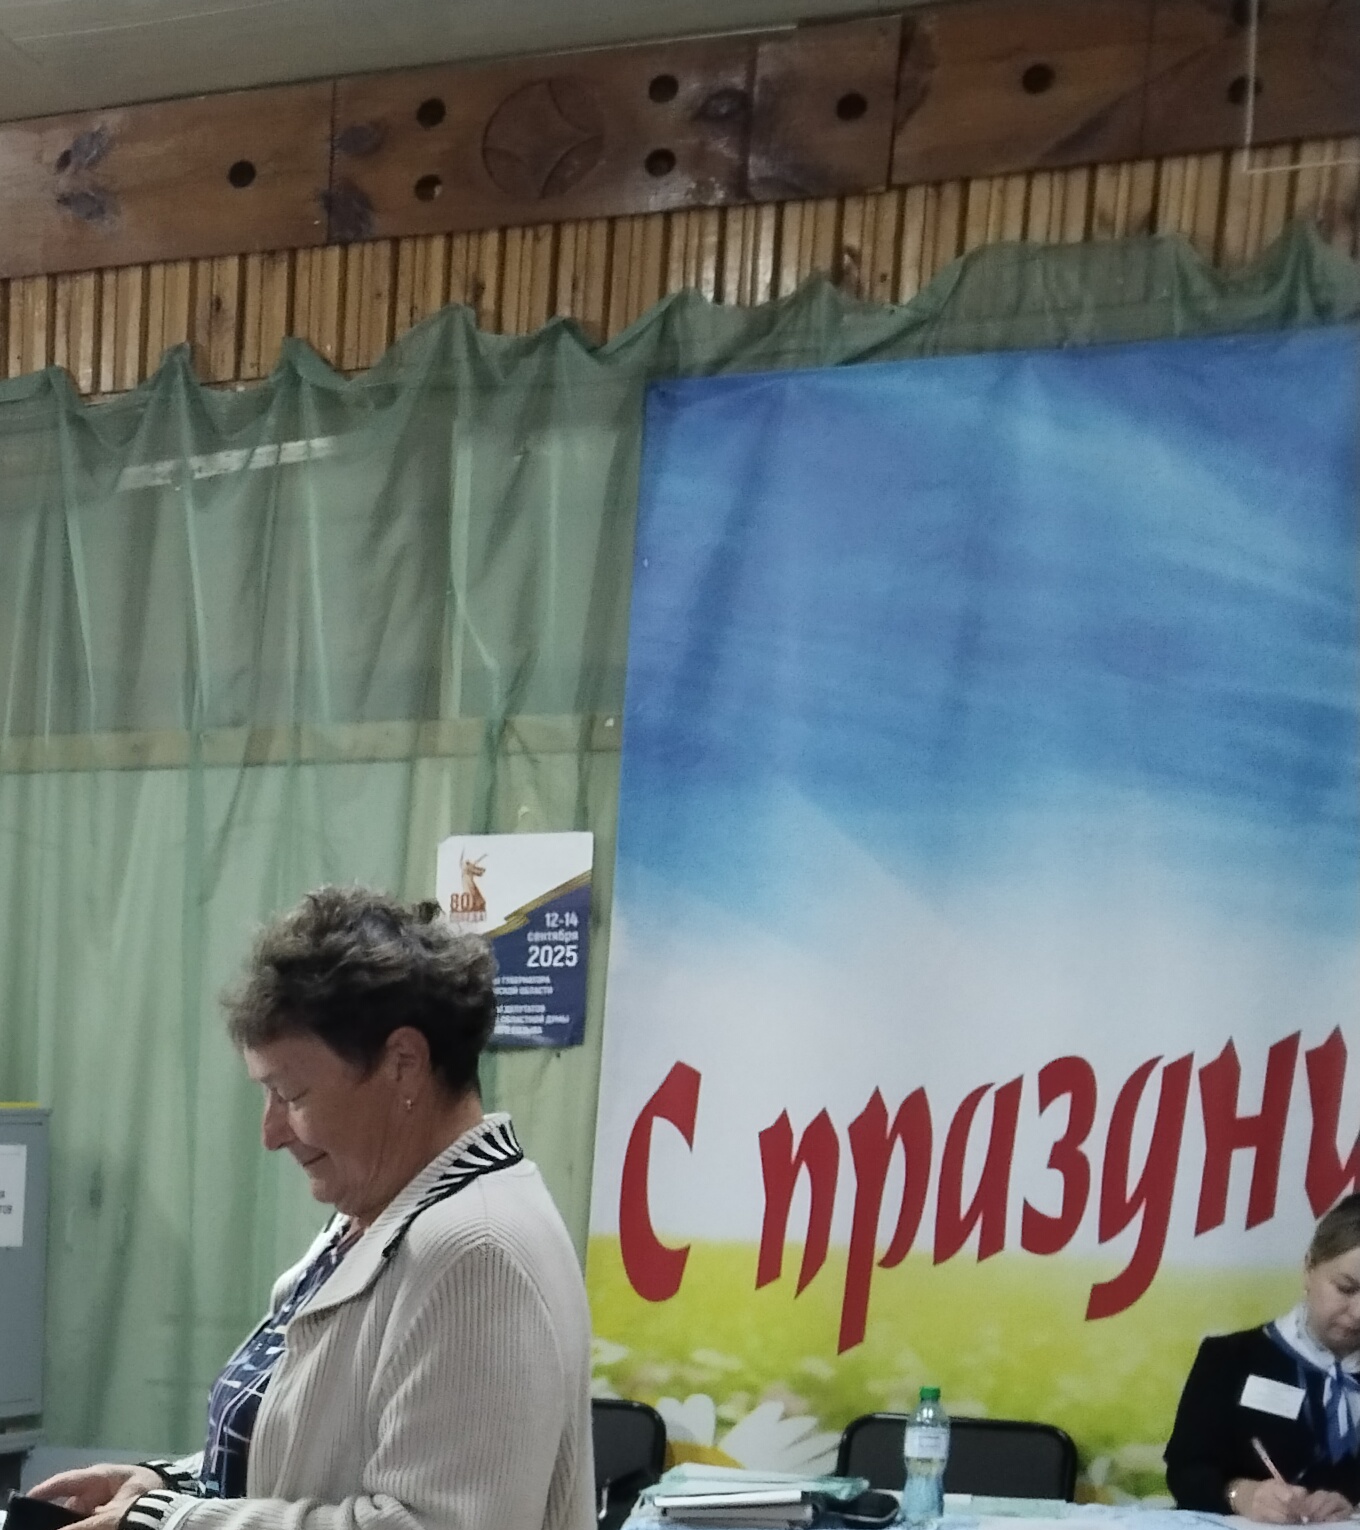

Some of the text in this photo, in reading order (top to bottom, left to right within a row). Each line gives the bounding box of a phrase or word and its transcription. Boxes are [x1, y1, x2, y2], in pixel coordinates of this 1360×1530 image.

[545, 912, 578, 927] 12-14
[527, 930, 578, 943] сентября
[527, 945, 579, 967] 2025
[619, 1060, 701, 1302] С
